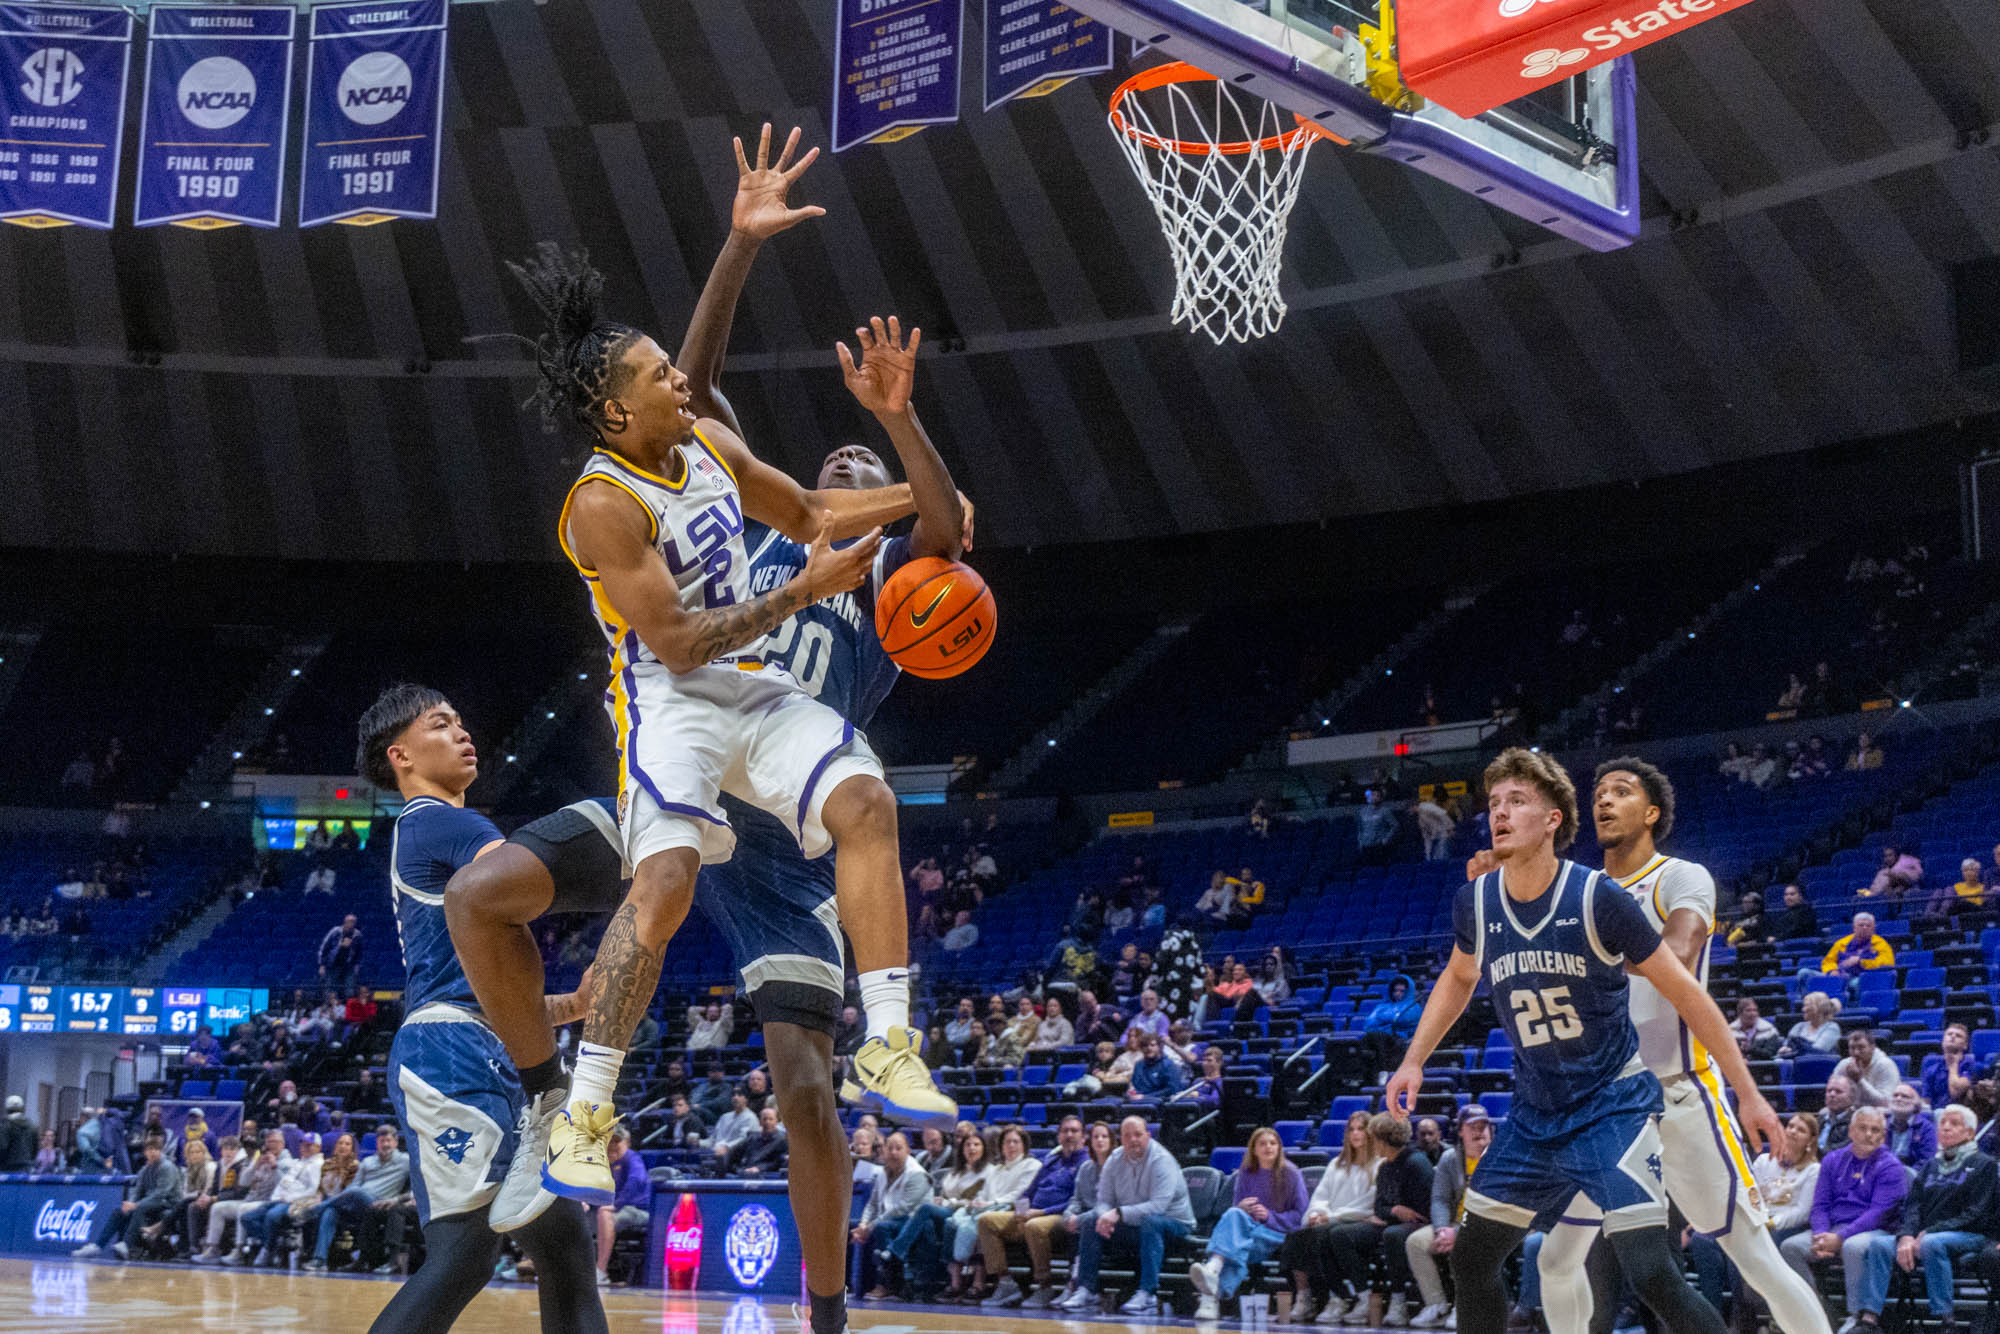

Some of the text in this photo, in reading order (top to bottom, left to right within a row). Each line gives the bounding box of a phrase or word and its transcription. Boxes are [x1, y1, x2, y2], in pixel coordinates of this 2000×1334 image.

[189, 16, 255, 28] VOLLEYBALL
[348, 10, 410, 25] VOLLEYBALL
[887, 13, 927, 33] SEASONS
[999, 12, 1041, 36] JACKSON
[1581, 0, 1716, 50] State
[901, 25, 931, 42] FINALS
[999, 21, 1070, 56] CLARE-KEARNEY
[861, 53, 878, 67] SEC
[879, 32, 948, 60] CHAMPIONSHIPS
[901, 62, 941, 82] NATIONAL
[999, 49, 1048, 76] COURVILLE
[20, 47, 86, 107] SEC
[859, 87, 887, 104] COACH
[900, 79, 917, 93] THE
[917, 72, 941, 88] YEAR
[185, 91, 251, 110] NCAA
[344, 85, 408, 107] NCAA
[10, 115, 88, 131] CHAMPIONS
[166, 156, 255, 172] FINAL FOUR
[328, 150, 411, 170] FINAL FOUR
[177, 175, 240, 199] 1990
[342, 170, 395, 196] 1991
[663, 493, 744, 577] LSU
[704, 547, 736, 610] 2
[937, 617, 982, 659] LSU
[1489, 949, 1588, 986] NEW ORLEANS
[29, 995, 50, 1013] 10
[70, 992, 113, 1013] 15.7
[135, 997, 148, 1013] 9
[168, 992, 202, 1006] LSU
[171, 1009, 198, 1033] 91
[1509, 985, 1586, 1049] 25
